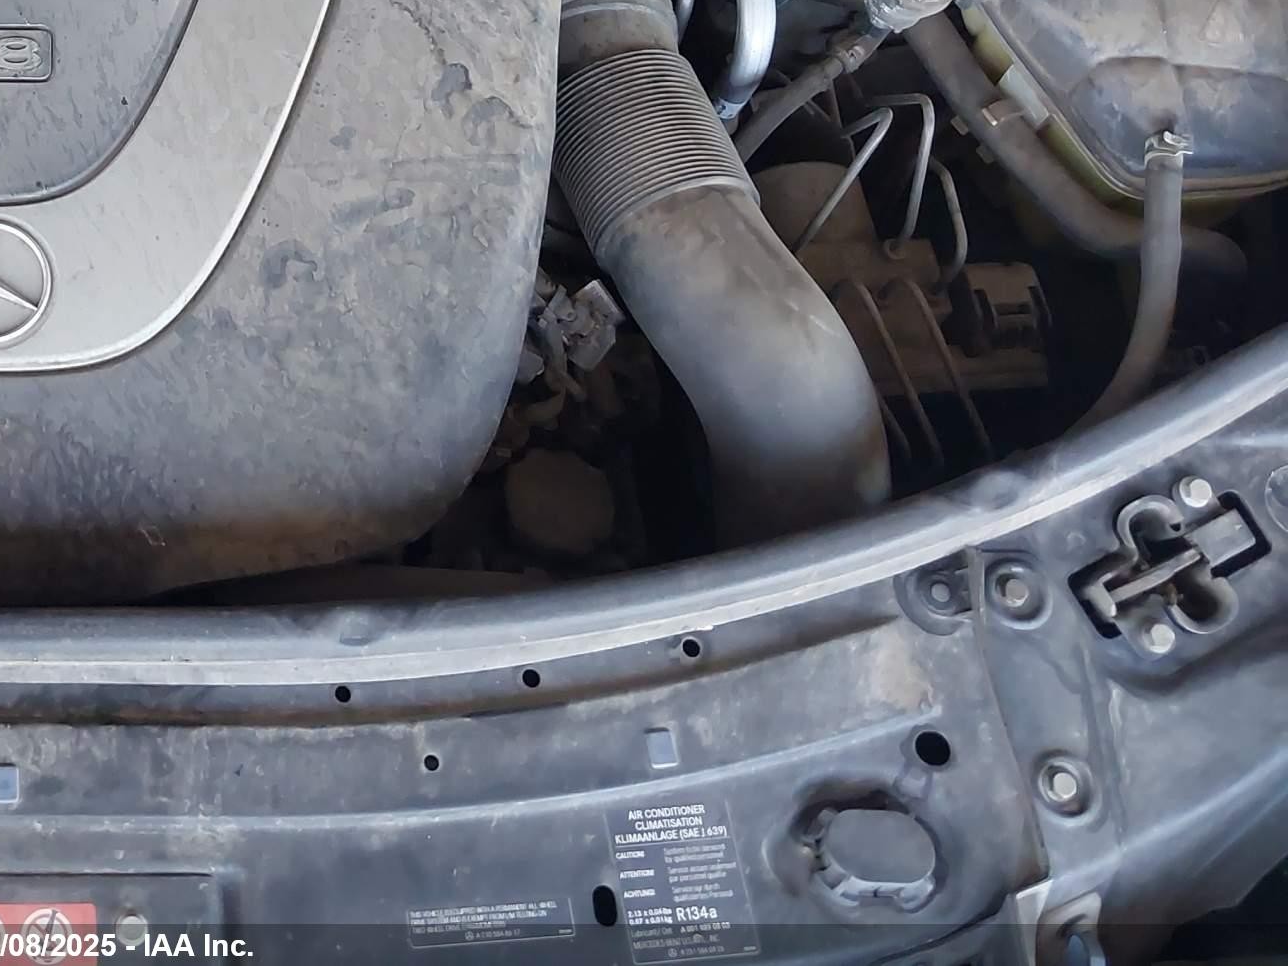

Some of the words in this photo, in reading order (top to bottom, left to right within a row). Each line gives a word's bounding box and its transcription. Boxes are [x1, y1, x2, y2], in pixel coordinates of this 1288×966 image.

[628, 809, 643, 820] AIR
[644, 805, 706, 819] CONDITIONER
[634, 816, 703, 831] CLIMATISATION
[614, 830, 677, 844] KLIMAANLAGE
[679, 828, 699, 840] (SAE
[707, 825, 727, 837] 639)
[675, 905, 718, 922] R134a
